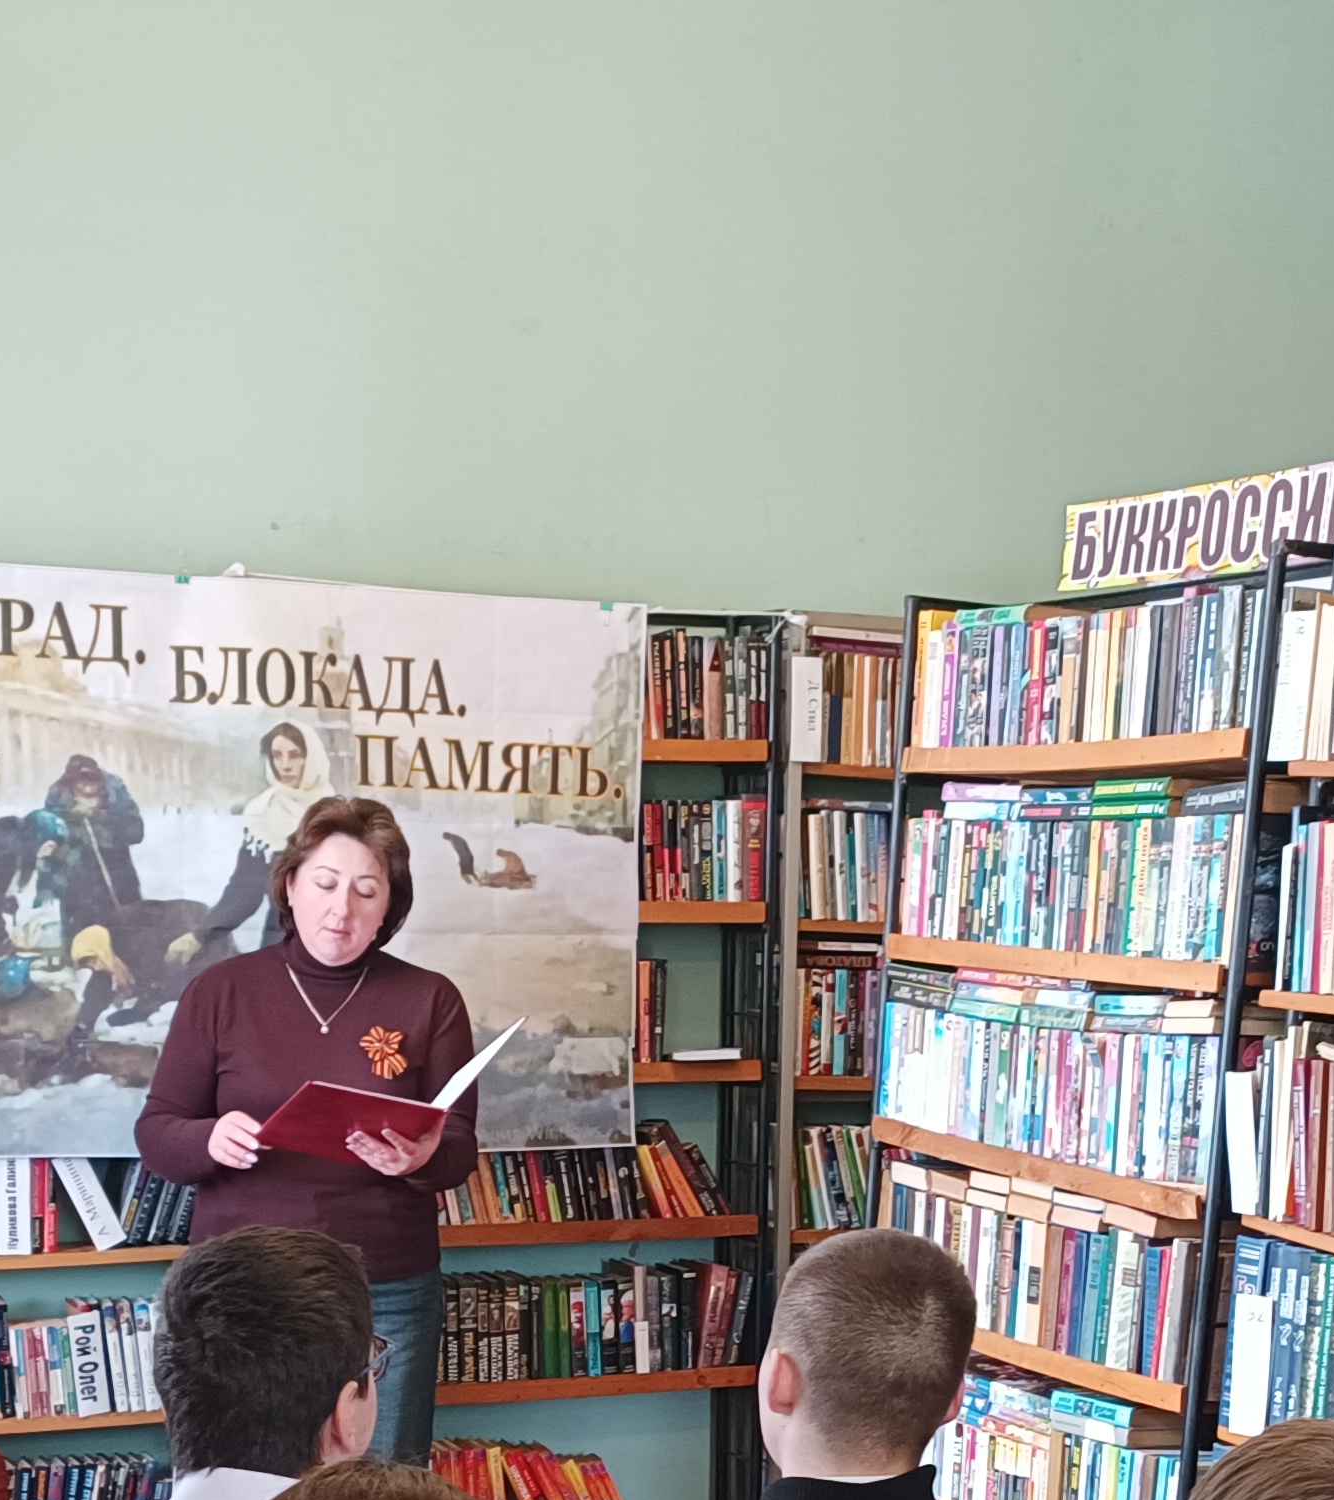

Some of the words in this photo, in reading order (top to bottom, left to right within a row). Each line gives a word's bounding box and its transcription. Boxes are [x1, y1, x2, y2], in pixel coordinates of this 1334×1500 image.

[168, 644, 467, 727] БЛОКАДА.
[807, 698, 820, 731] Стил
[356, 734, 624, 801] ПАМЯТЬ.
[73, 1324, 97, 1357] Рой
[78, 1362, 100, 1404] Олег
